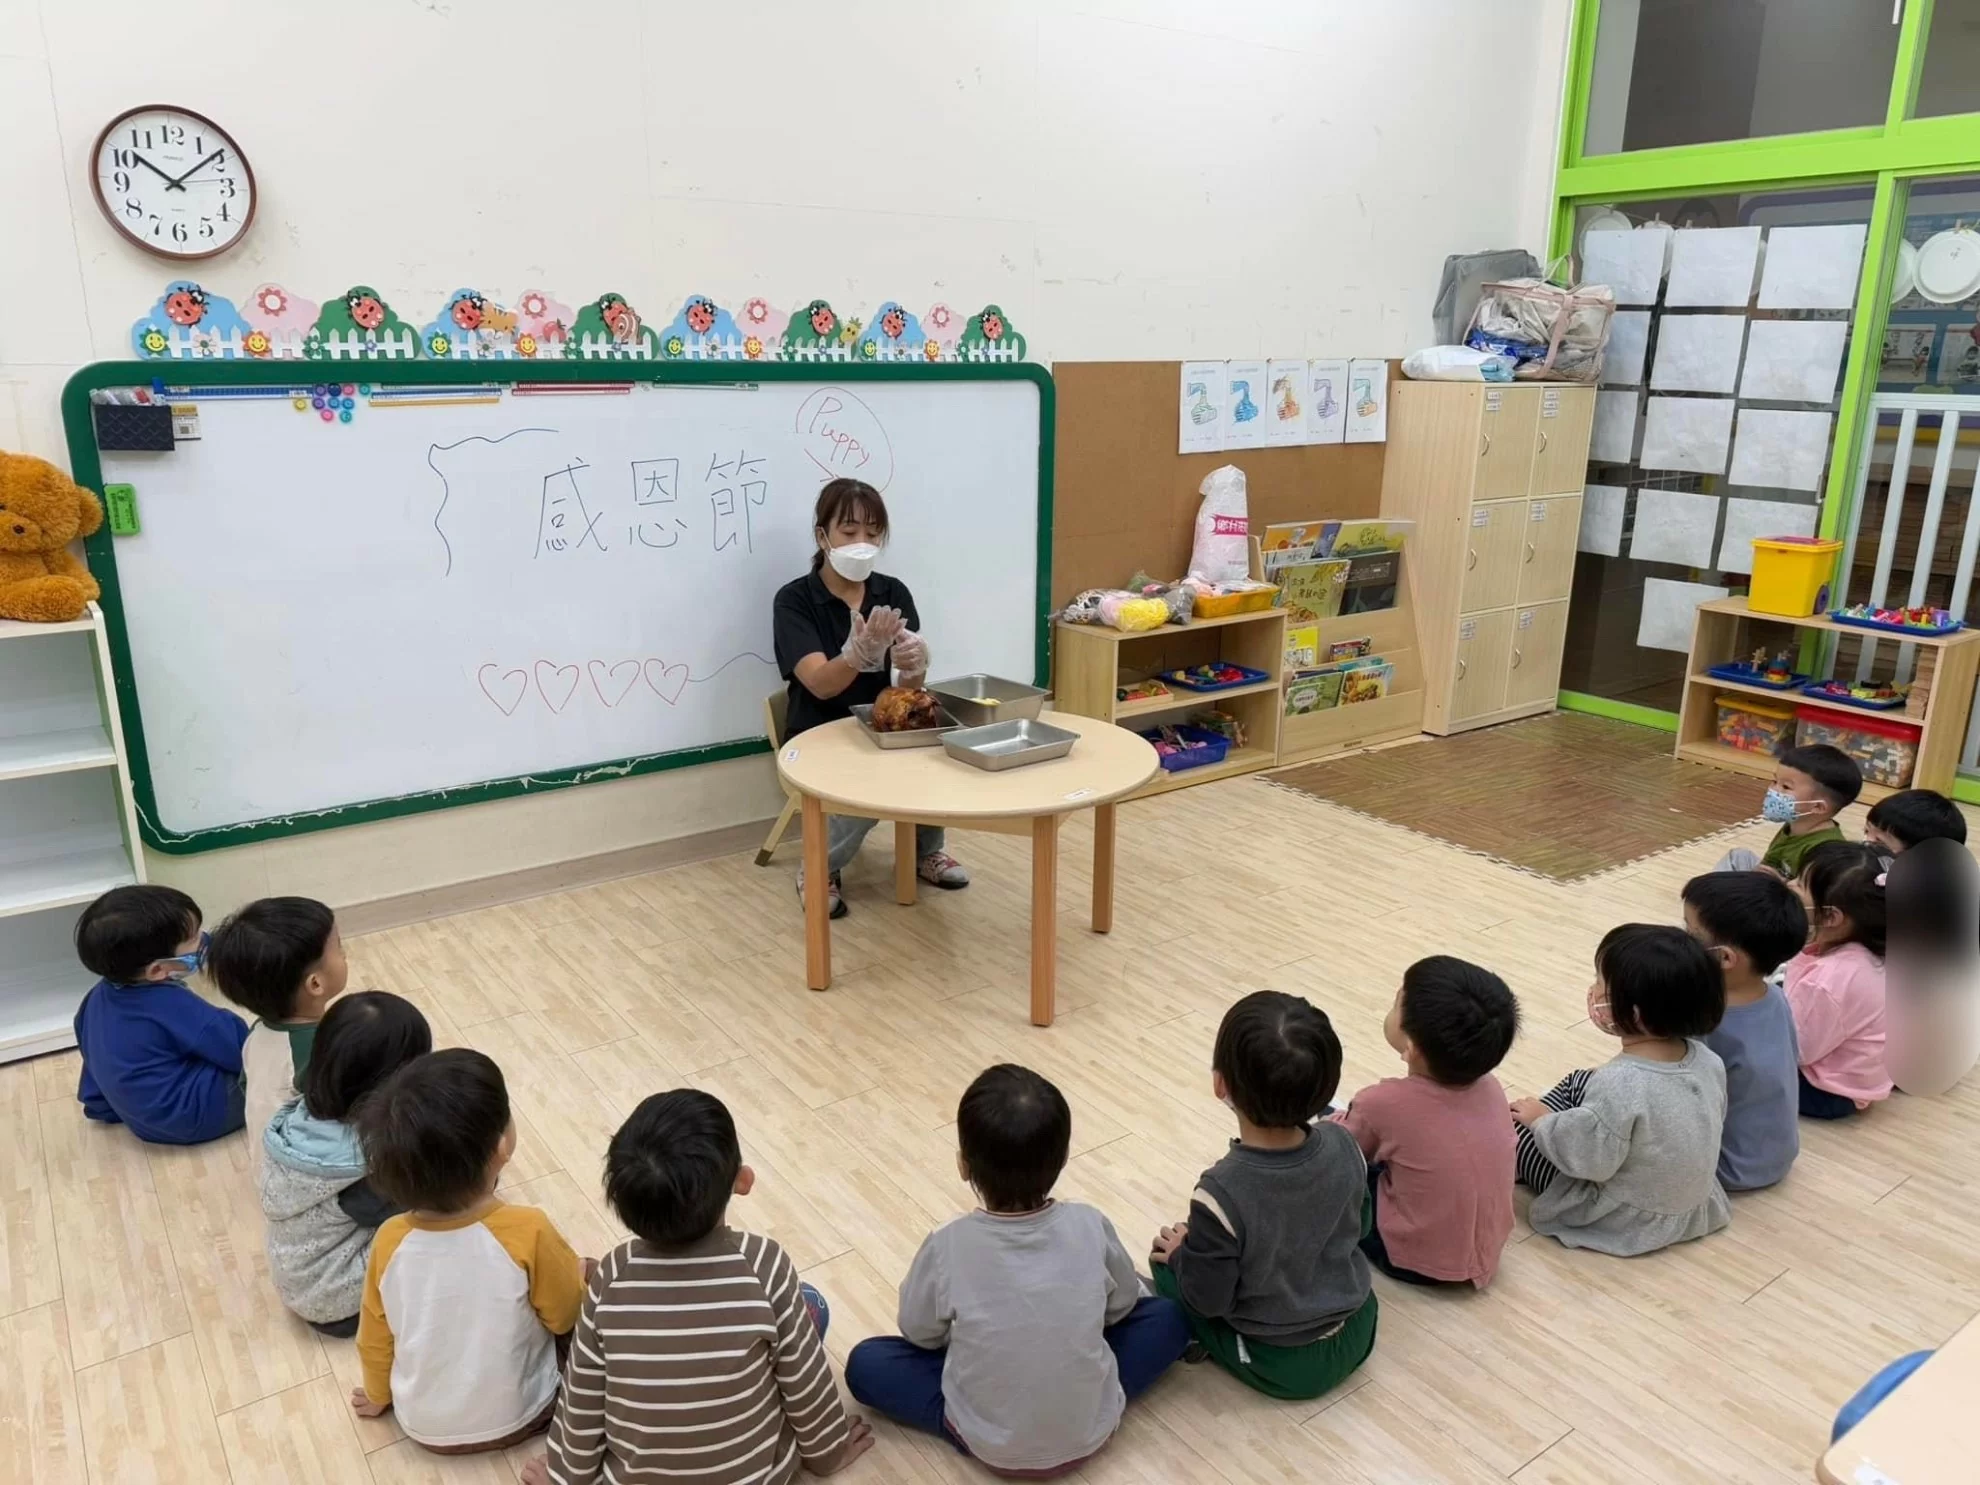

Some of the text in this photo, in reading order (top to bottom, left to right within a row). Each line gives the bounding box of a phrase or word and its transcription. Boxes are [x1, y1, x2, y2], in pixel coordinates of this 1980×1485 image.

[130, 129, 153, 150] 11
[161, 124, 185, 146] 12
[195, 136, 203, 155] 1
[113, 148, 139, 169] 10
[210, 150, 225, 173] 2
[114, 171, 130, 193] 9
[219, 178, 236, 199] 3
[125, 197, 143, 220] 8
[216, 202, 231, 222] 4
[149, 214, 163, 236] 7
[172, 222, 188, 242] 6
[199, 217, 214, 238] 5
[808, 396, 870, 469] Puppy
[533, 449, 767, 560] 感恩節
